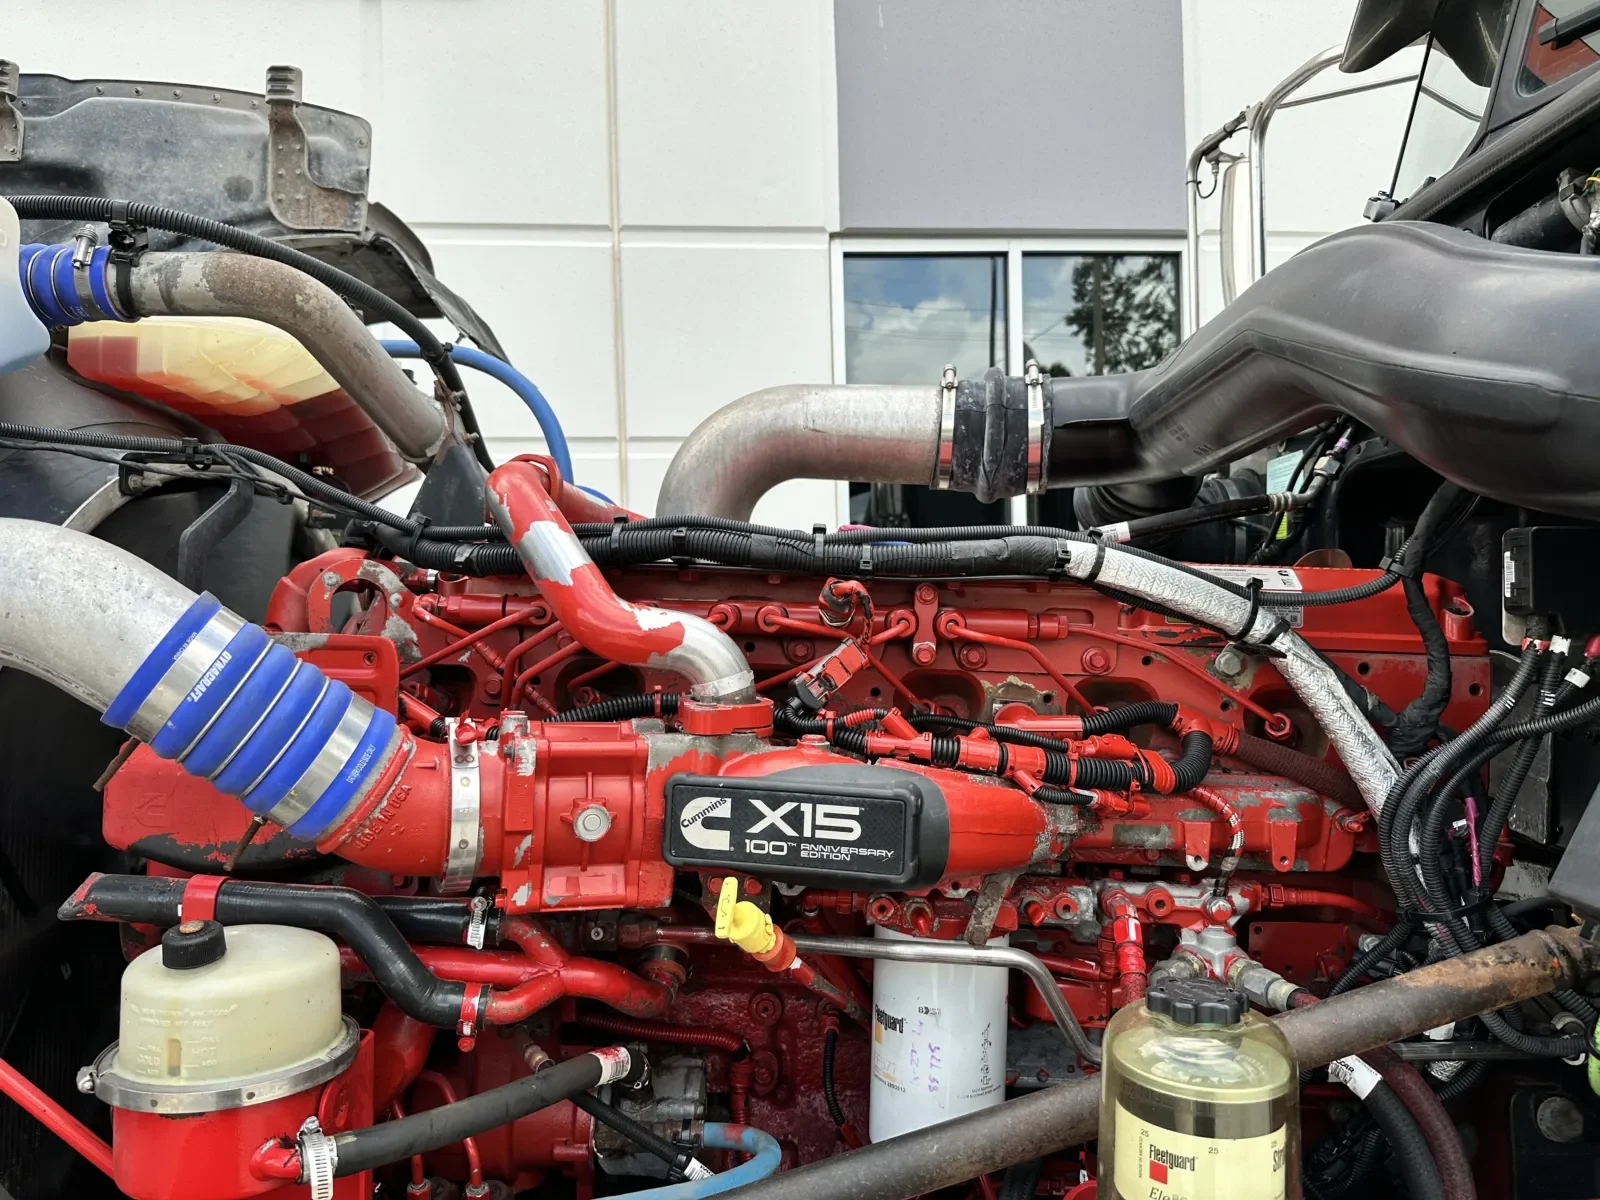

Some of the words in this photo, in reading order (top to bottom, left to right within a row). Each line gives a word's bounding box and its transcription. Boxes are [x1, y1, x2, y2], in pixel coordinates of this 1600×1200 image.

[191, 650, 233, 702] DYNACRAFT
[379, 807, 397, 824] IN
[389, 785, 412, 809] USA
[680, 797, 727, 828] Cummins
[745, 799, 862, 841] X15
[800, 843, 895, 858] ANNIVERSARY
[800, 850, 851, 861] EDITION
[191, 1046, 217, 1057] HOT
[1140, 1128, 1150, 1138] 25
[1149, 1144, 1196, 1172] Fleetguard
[1207, 1146, 1219, 1155] 25
